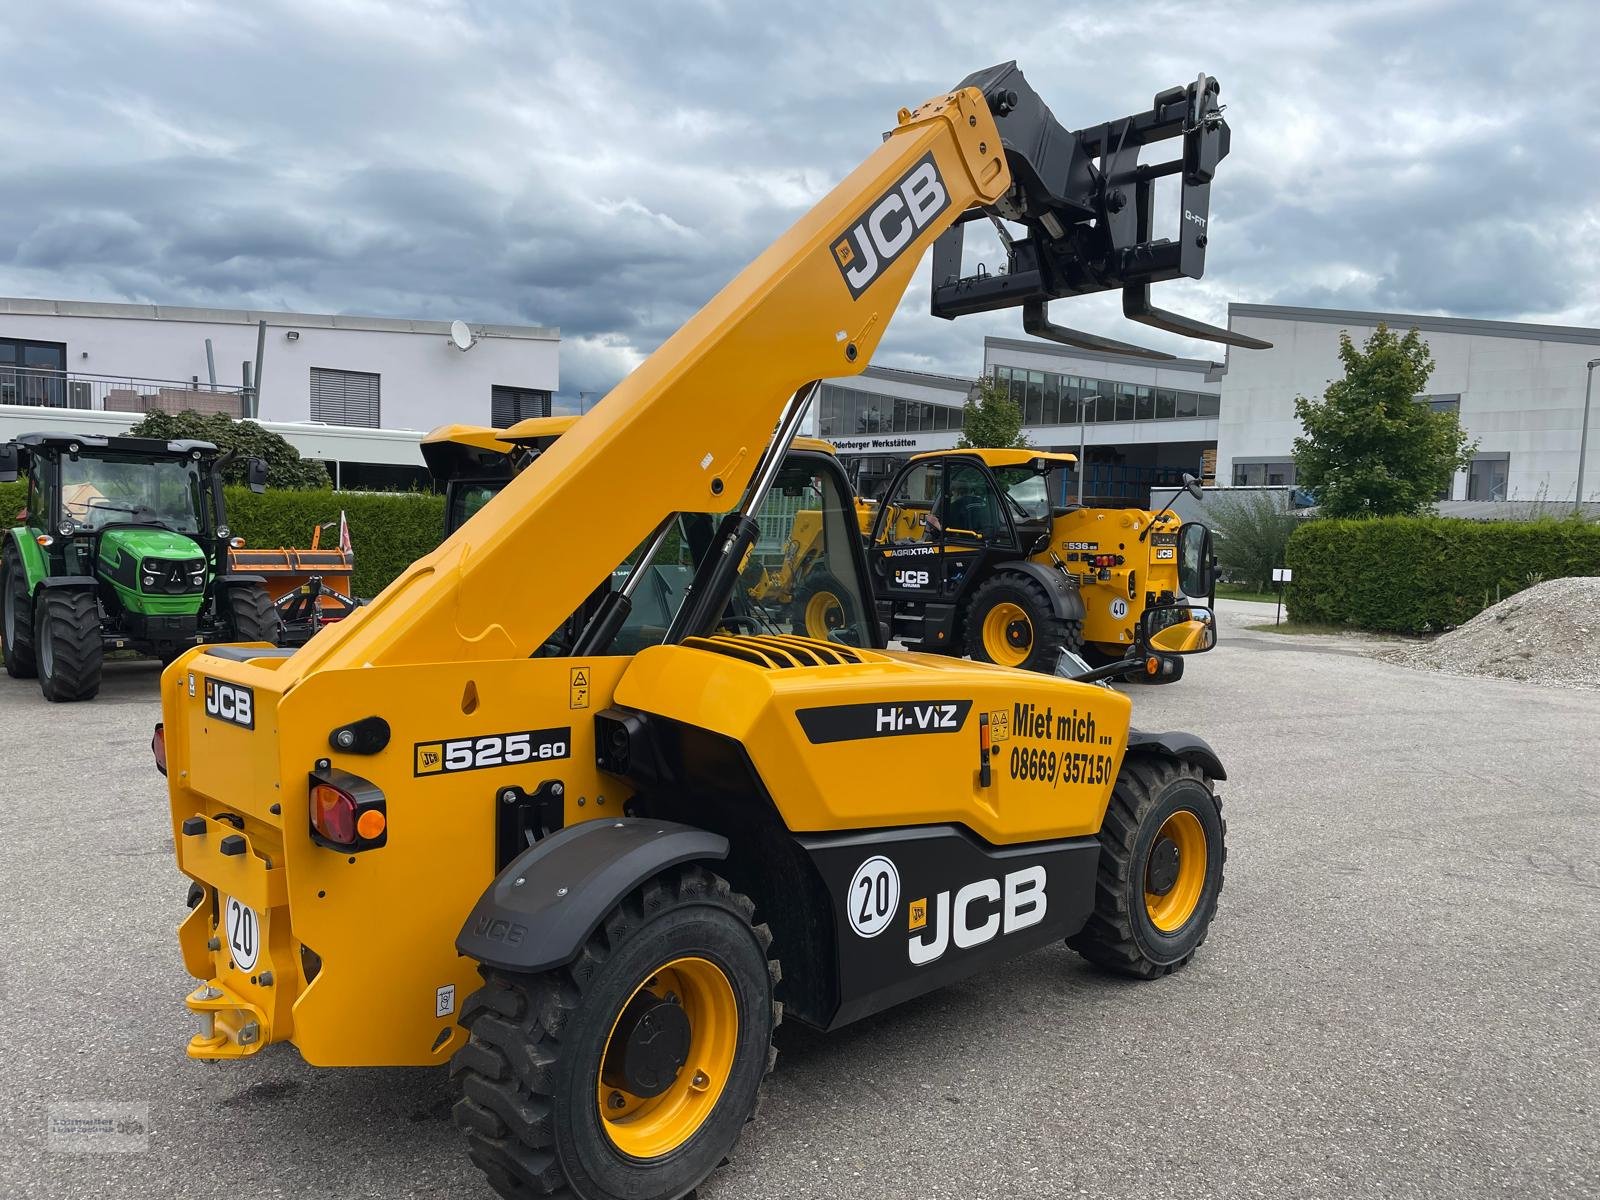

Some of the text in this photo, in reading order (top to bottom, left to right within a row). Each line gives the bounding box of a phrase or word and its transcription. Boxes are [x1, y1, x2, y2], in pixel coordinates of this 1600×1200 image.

[846, 162, 945, 289] JCB
[872, 439, 916, 448] Werkstätten
[891, 547, 934, 557] AGRIXTRA
[1157, 550, 1173, 559] JCB
[895, 570, 929, 584] JCB
[1113, 602, 1126, 617] 40
[207, 683, 251, 724] JCB
[1012, 702, 1052, 739] Miet
[1056, 709, 1096, 743] mich
[445, 734, 566, 770] 525-60
[1010, 746, 1112, 789] 08669/357150
[858, 870, 890, 925] 20
[909, 865, 1047, 966] JCB
[231, 901, 252, 958] 20
[473, 915, 529, 948] JCB
